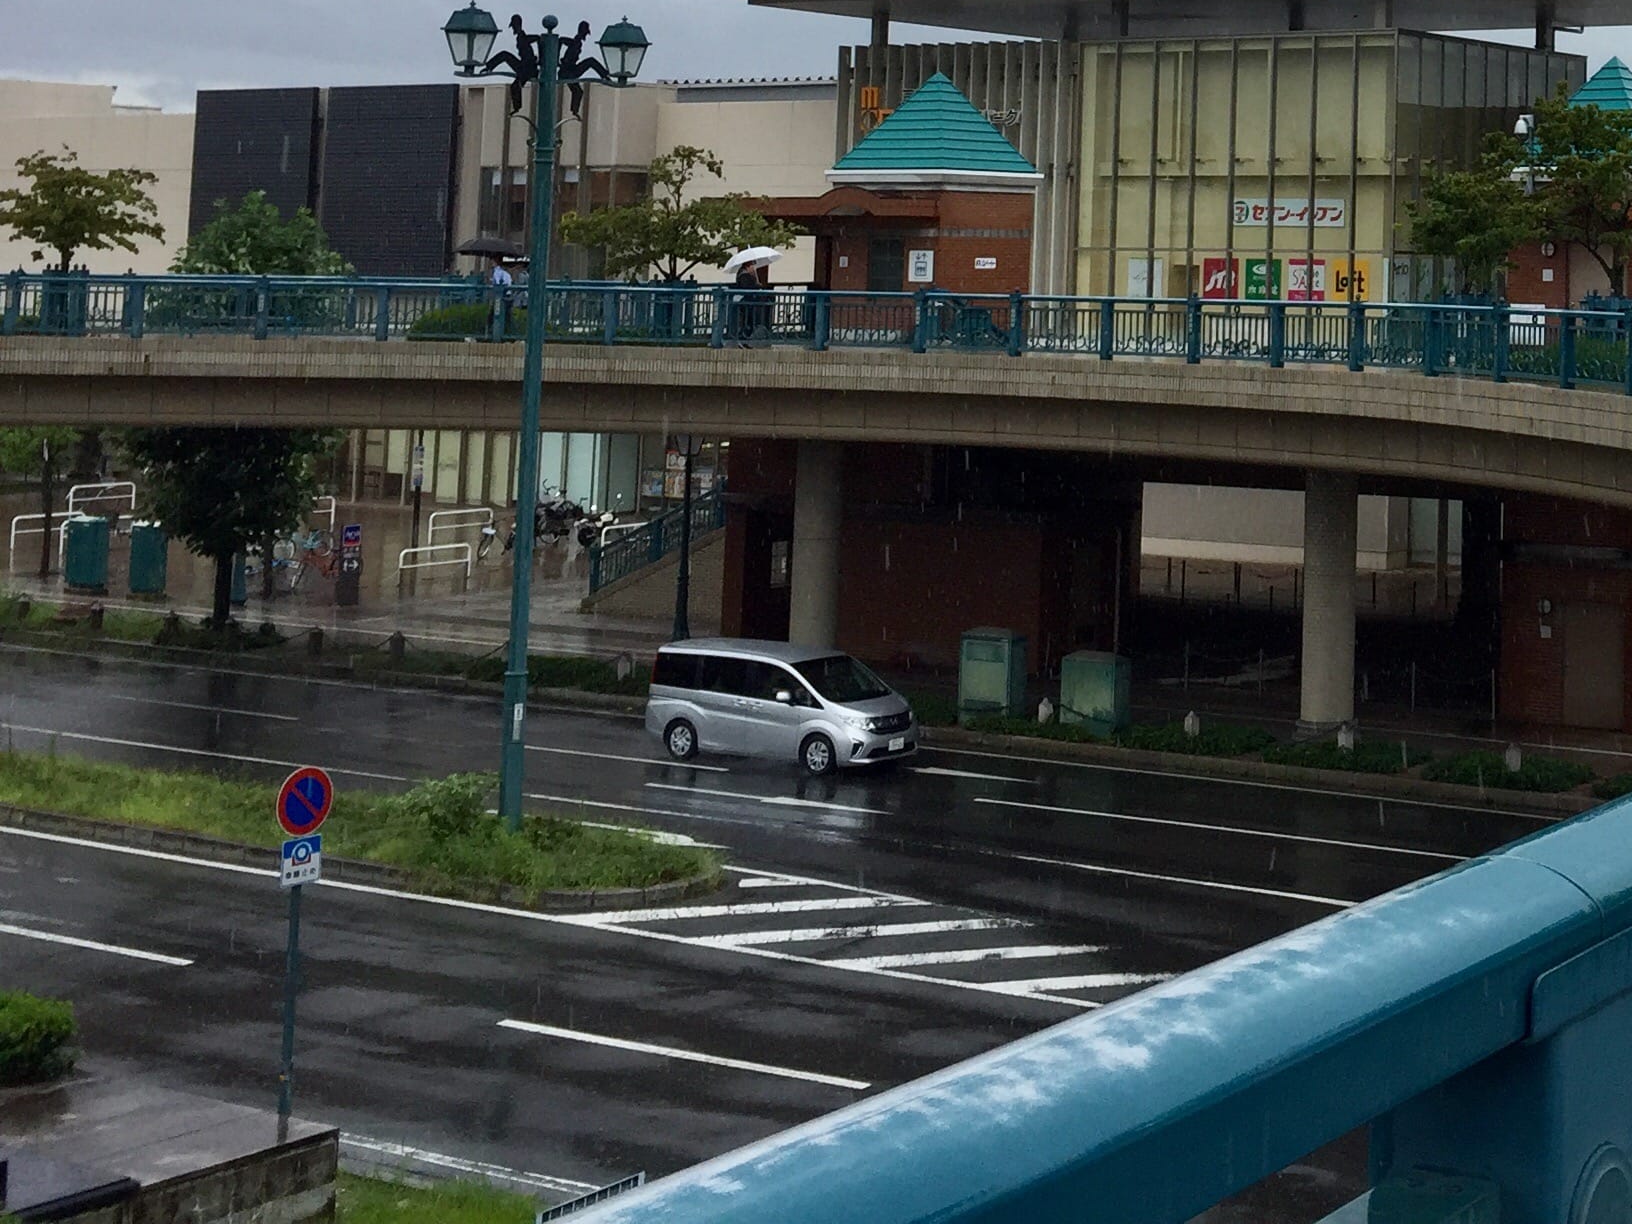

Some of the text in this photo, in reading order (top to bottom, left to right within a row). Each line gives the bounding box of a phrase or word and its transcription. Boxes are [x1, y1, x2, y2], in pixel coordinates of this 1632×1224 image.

[1252, 204, 1343, 222] セン-イブン
